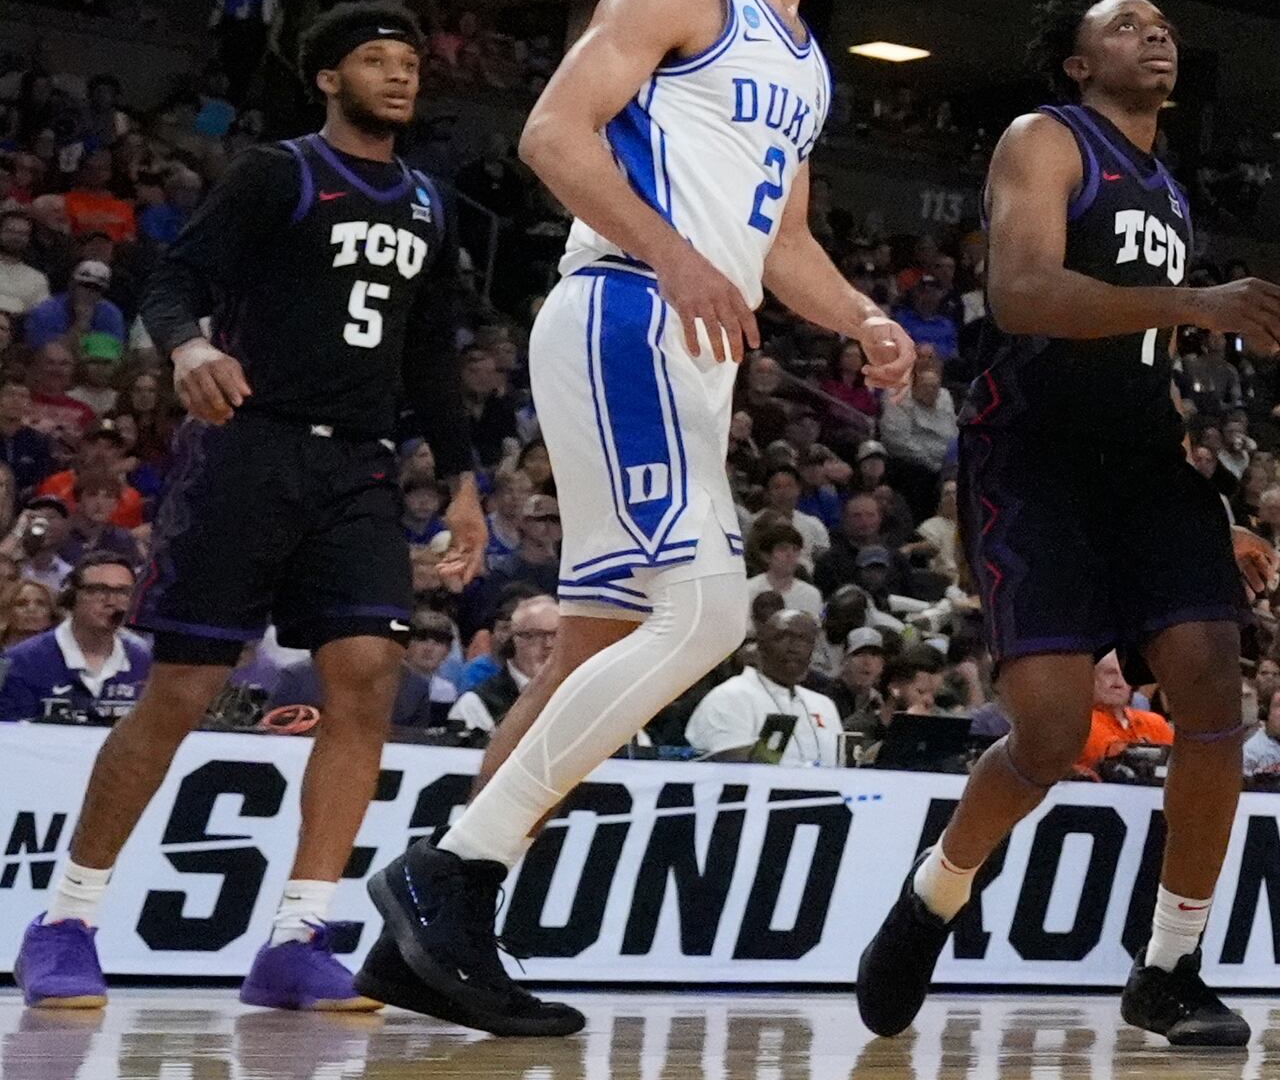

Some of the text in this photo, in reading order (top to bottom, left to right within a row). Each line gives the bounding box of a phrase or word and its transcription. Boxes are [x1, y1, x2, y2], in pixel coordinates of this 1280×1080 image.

[747, 145, 787, 236] 2
[330, 220, 428, 281] TCU
[1114, 209, 1186, 286] TCU
[342, 280, 391, 350] 5
